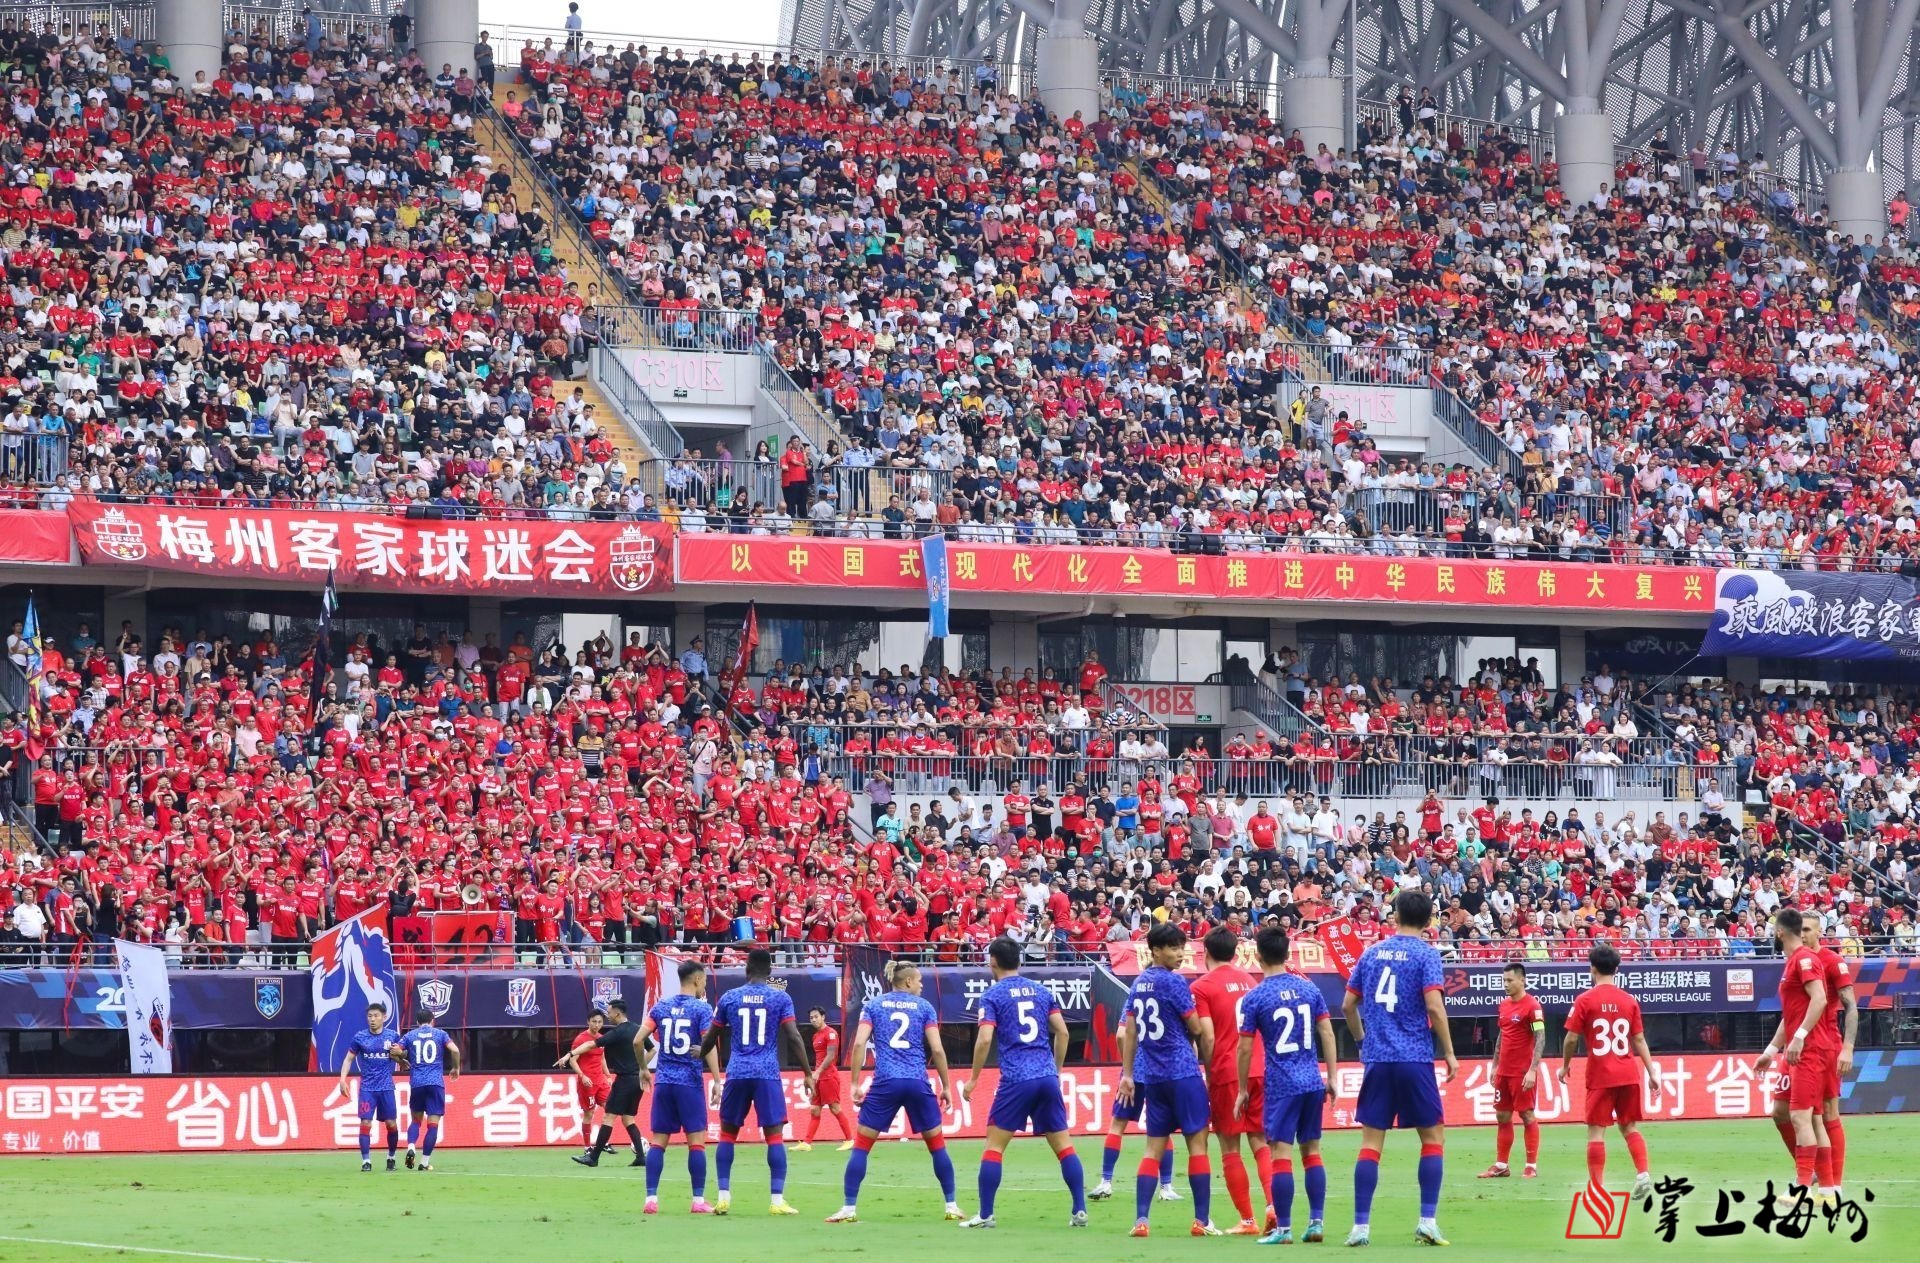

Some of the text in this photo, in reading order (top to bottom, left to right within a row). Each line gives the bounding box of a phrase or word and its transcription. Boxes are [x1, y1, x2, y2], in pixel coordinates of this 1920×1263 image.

[156, 513, 596, 584] 梅州客家球迷会
[731, 542, 1702, 601] 以中国式现代化全面推进中华民族伟大复兴
[1375, 965, 1398, 1013] 4
[1445, 996, 1467, 1006] PING
[1469, 996, 1483, 1006] AN
[1643, 993, 1674, 1002] SUPER
[1675, 992, 1711, 1002] LEAGUE
[1469, 971, 1711, 991] 中国安中国足协会超级联赛
[661, 1018, 691, 1055] 15
[737, 1007, 767, 1046] 11
[888, 1011, 911, 1049] 2
[1017, 1000, 1039, 1043] 5
[1133, 997, 1165, 1042] 33
[1272, 1003, 1311, 1055] 21
[1592, 1018, 1630, 1057] 38
[413, 1040, 437, 1064] 10
[0, 1083, 145, 1120] 国平安
[166, 1080, 300, 1149] 省心
